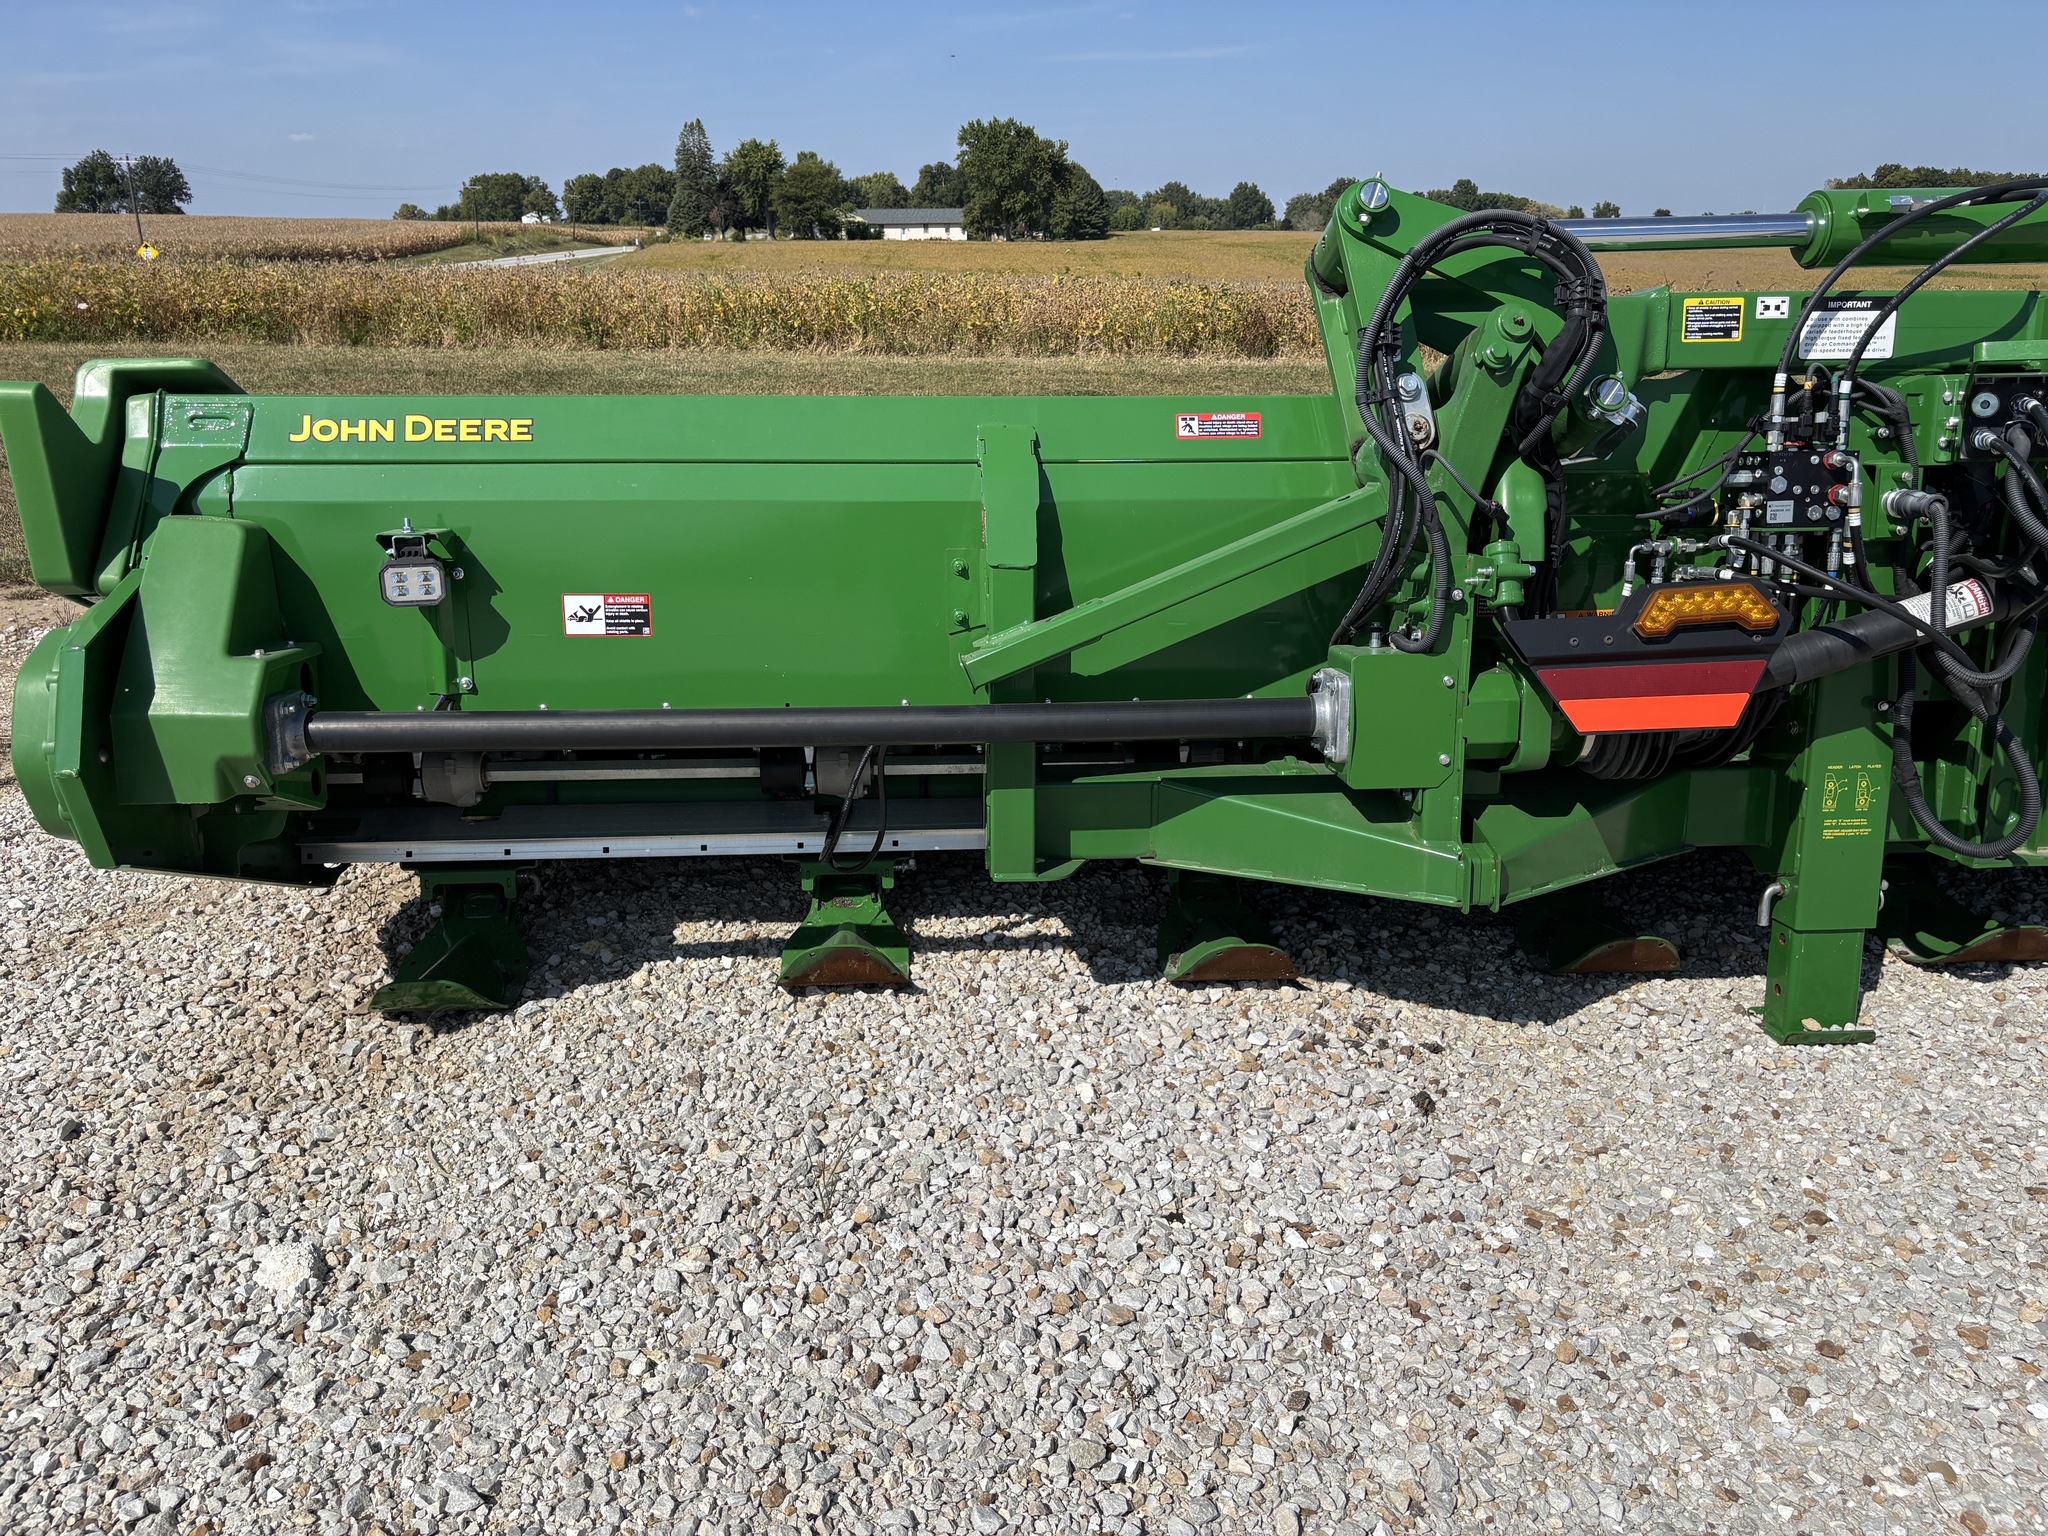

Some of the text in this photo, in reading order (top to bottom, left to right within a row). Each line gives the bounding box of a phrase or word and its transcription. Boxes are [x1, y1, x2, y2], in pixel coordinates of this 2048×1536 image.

[289, 414, 533, 443] JOHN DEERE
[1970, 583, 1990, 614] DANGER
